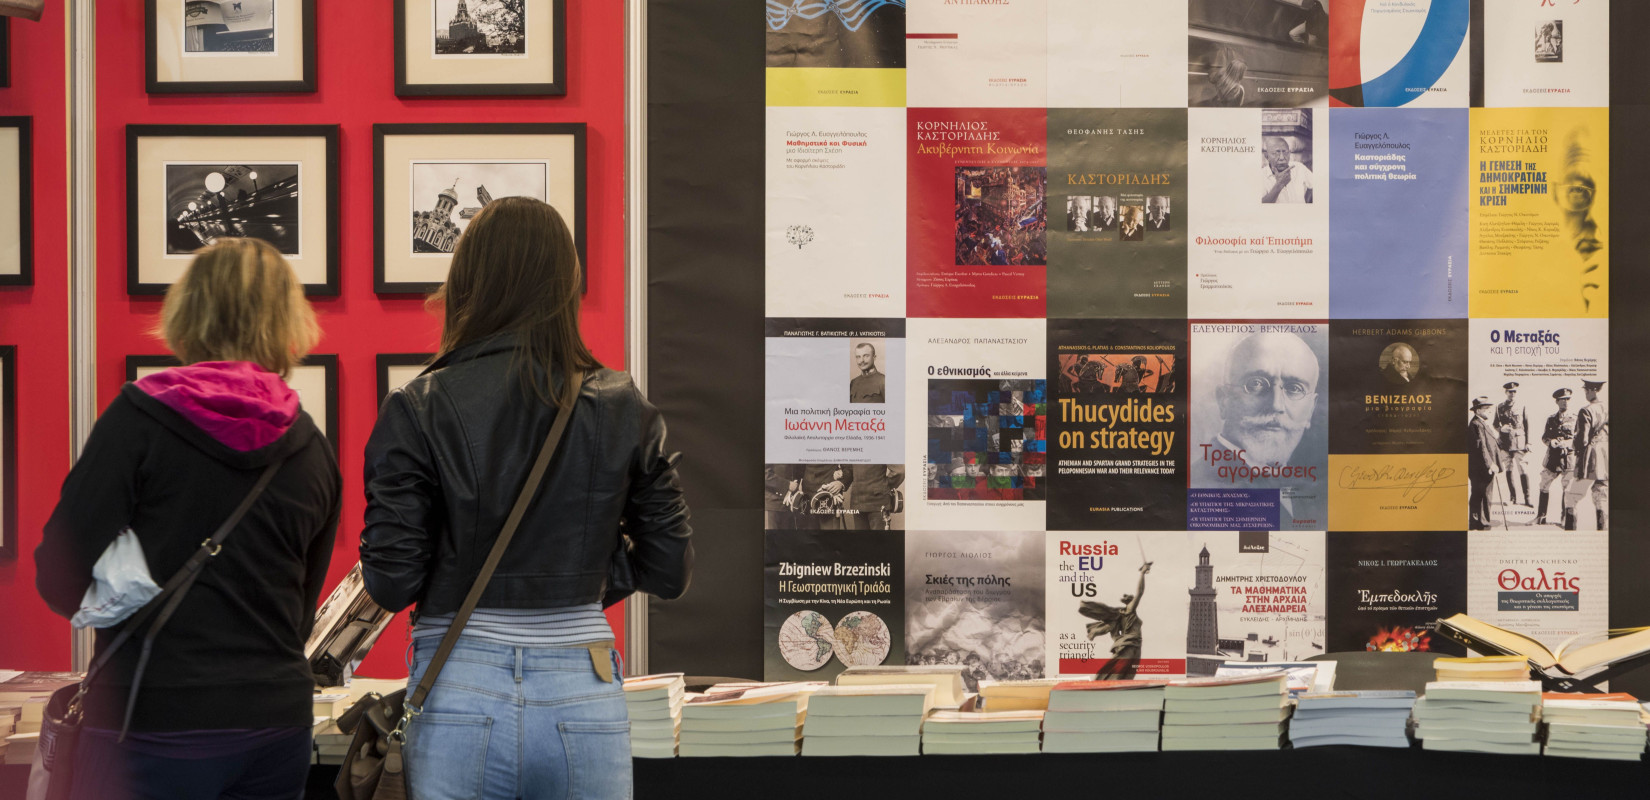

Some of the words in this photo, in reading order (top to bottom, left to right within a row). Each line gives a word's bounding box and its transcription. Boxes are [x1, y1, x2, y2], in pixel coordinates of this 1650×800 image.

[917, 121, 988, 130] ΚΟΡΝΗΛΙΟΣ
[917, 132, 1000, 140] ΚΑΣΤΟΡΙΑΔΗΣ
[1355, 132, 1381, 141] Γιώργος
[1480, 136, 1548, 145] ΚΟΡΝΗΛΙΟ
[917, 142, 983, 158] Ακυβέρνητη
[987, 143, 1039, 154] Κοινωνία
[1355, 142, 1410, 150] Ευαγγελόπουλος
[1480, 145, 1548, 154] ΚΑΣΤΟΡΙΑΔΗ
[1355, 154, 1406, 162] Καστοριάδης
[1369, 163, 1406, 171] σύγχρονη
[1480, 161, 1486, 171] Η
[1489, 161, 1522, 171] ΓΕΝΕΣΗ
[1067, 174, 1170, 185] ΚΑΣΤΟΡΙΑΔΗΣ
[1355, 173, 1386, 181] πολιτική
[1388, 173, 1416, 181] θεωρία
[1480, 172, 1547, 183] ΔΗΜΟΚΡΑΤΙΑΣ
[1480, 186, 1490, 194] ΚΑΙ
[1492, 186, 1496, 194] Η
[1499, 184, 1547, 194] ΣΗΜΕΡΙΝΗ
[1480, 196, 1507, 206] ΚΡΙΣΗ
[1196, 236, 1247, 246] Φιλοσοφία
[1193, 325, 1255, 333] ΕΛΕΥΘΕΡΙΟΣ
[1260, 325, 1317, 333] ΒΕΝΙΖΕΛΟΣ
[1352, 328, 1384, 336] HERBERT
[1490, 330, 1500, 342] Ο
[1504, 330, 1560, 346] Μεταξάς
[1490, 346, 1504, 354] και
[1506, 346, 1512, 356] η
[1514, 345, 1541, 357] εποχή
[1545, 346, 1560, 354] του
[928, 366, 935, 376] Ο
[937, 366, 991, 378] εθνικισμός
[1365, 395, 1432, 404] ΒΕΝΙΖΕΛΟΣ
[800, 408, 831, 416] πολιτική
[833, 408, 870, 417] βιογραφία
[1059, 398, 1175, 429] Thucydides
[785, 418, 832, 433] Ιωάννη
[835, 418, 885, 433] Μεταξά
[1059, 430, 1084, 449] on
[1090, 428, 1175, 456] strategy
[1199, 444, 1246, 465] Τρεις
[1217, 462, 1317, 483] αγορεύσεις
[1059, 540, 1118, 556] Russia
[1059, 561, 1074, 571] the
[1078, 556, 1103, 571] EU
[779, 562, 832, 579] Zbigniew
[834, 562, 891, 576] Brzezinski
[925, 574, 954, 587] Σκιές
[956, 576, 974, 587] της
[977, 575, 1011, 587] πόλης
[1059, 572, 1077, 582] and
[1079, 573, 1094, 582] the
[779, 581, 787, 592] Η
[788, 580, 857, 596] Γεωστρατηγική
[859, 580, 891, 594] Τριάδα
[1071, 583, 1097, 597] US
[1245, 586, 1307, 594] ΜΑΘΗΜΑΤΙΚΑ
[1242, 604, 1307, 613] ΑΛΕΞΑΝΔΡΕΙΑ
[1059, 641, 1096, 651] security
[1059, 649, 1095, 662] triangle
